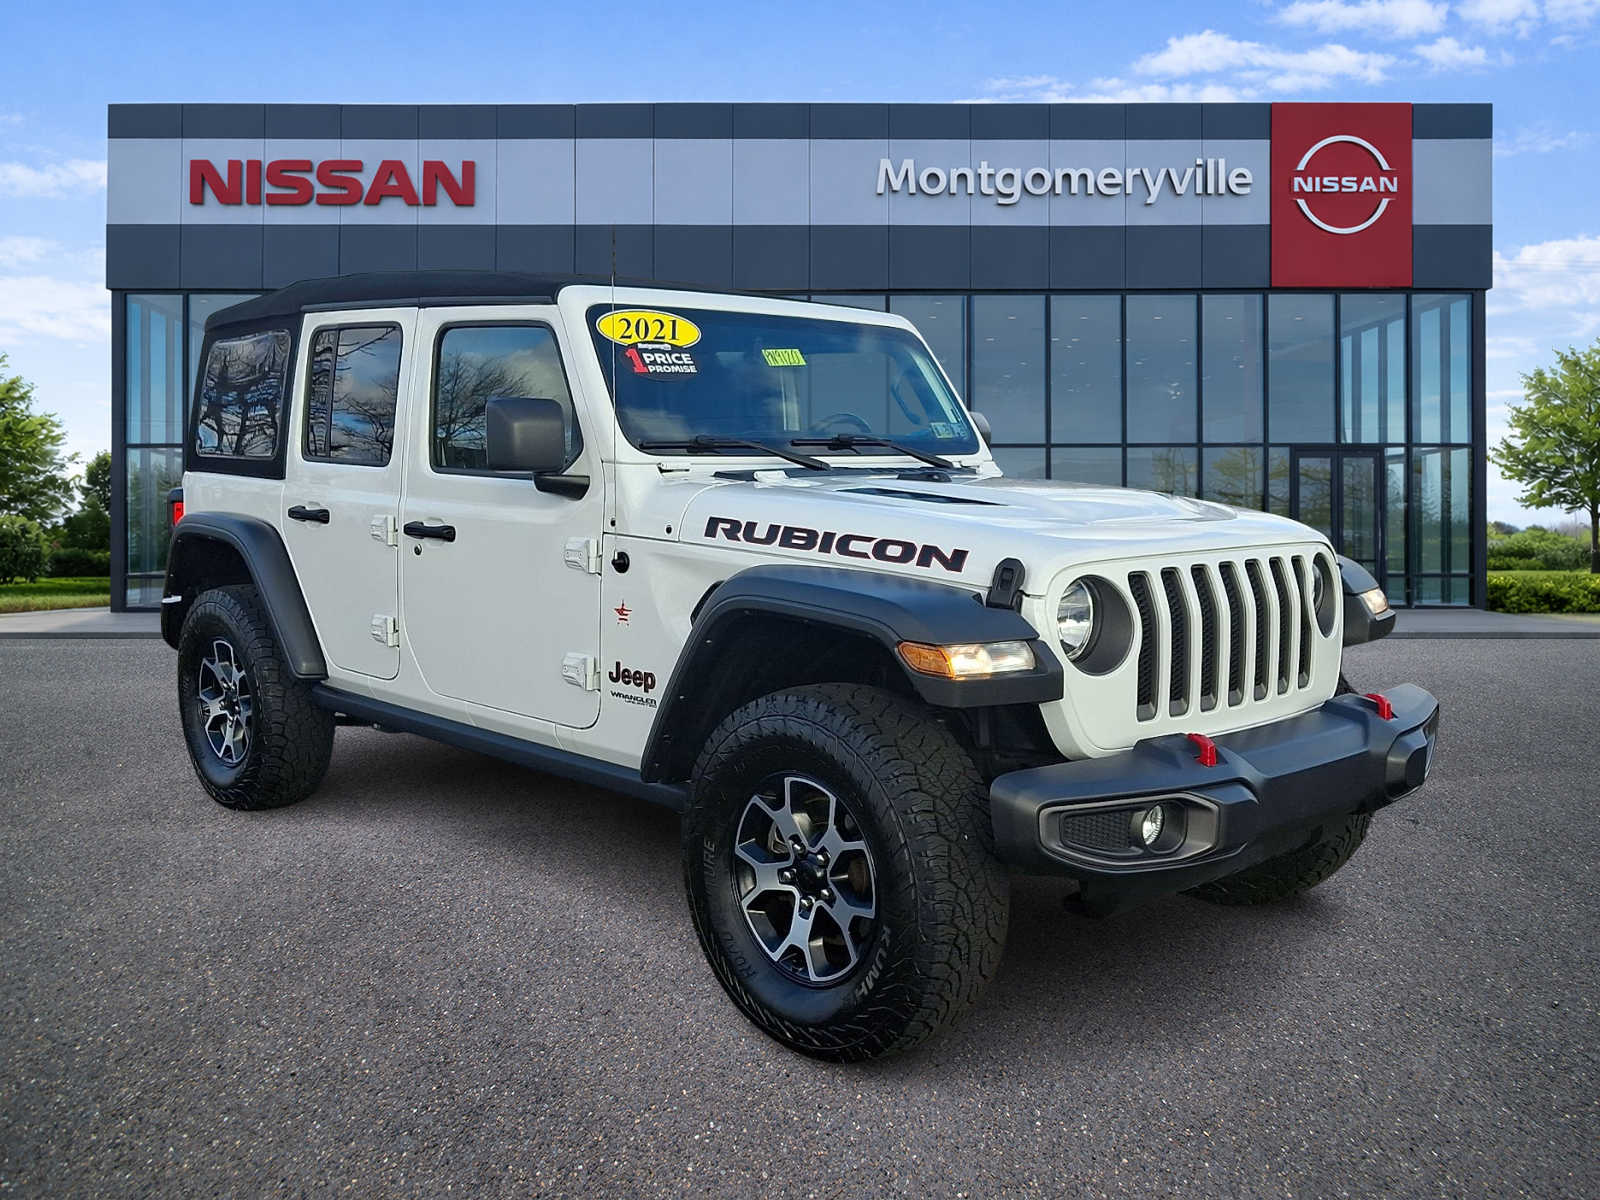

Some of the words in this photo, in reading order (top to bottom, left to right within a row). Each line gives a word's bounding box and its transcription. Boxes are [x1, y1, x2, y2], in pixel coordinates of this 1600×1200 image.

[190, 159, 476, 207] NISSAN
[876, 158, 1253, 206] Montgomeryville
[1293, 176, 1398, 193] NISSAN
[617, 318, 680, 341] 2021
[625, 347, 649, 373] 1
[642, 352, 694, 364] PRICE
[647, 364, 698, 373] PROMISE
[704, 516, 969, 573] RUBICON
[608, 661, 656, 693] Jeep
[852, 924, 890, 1000] KUMH
